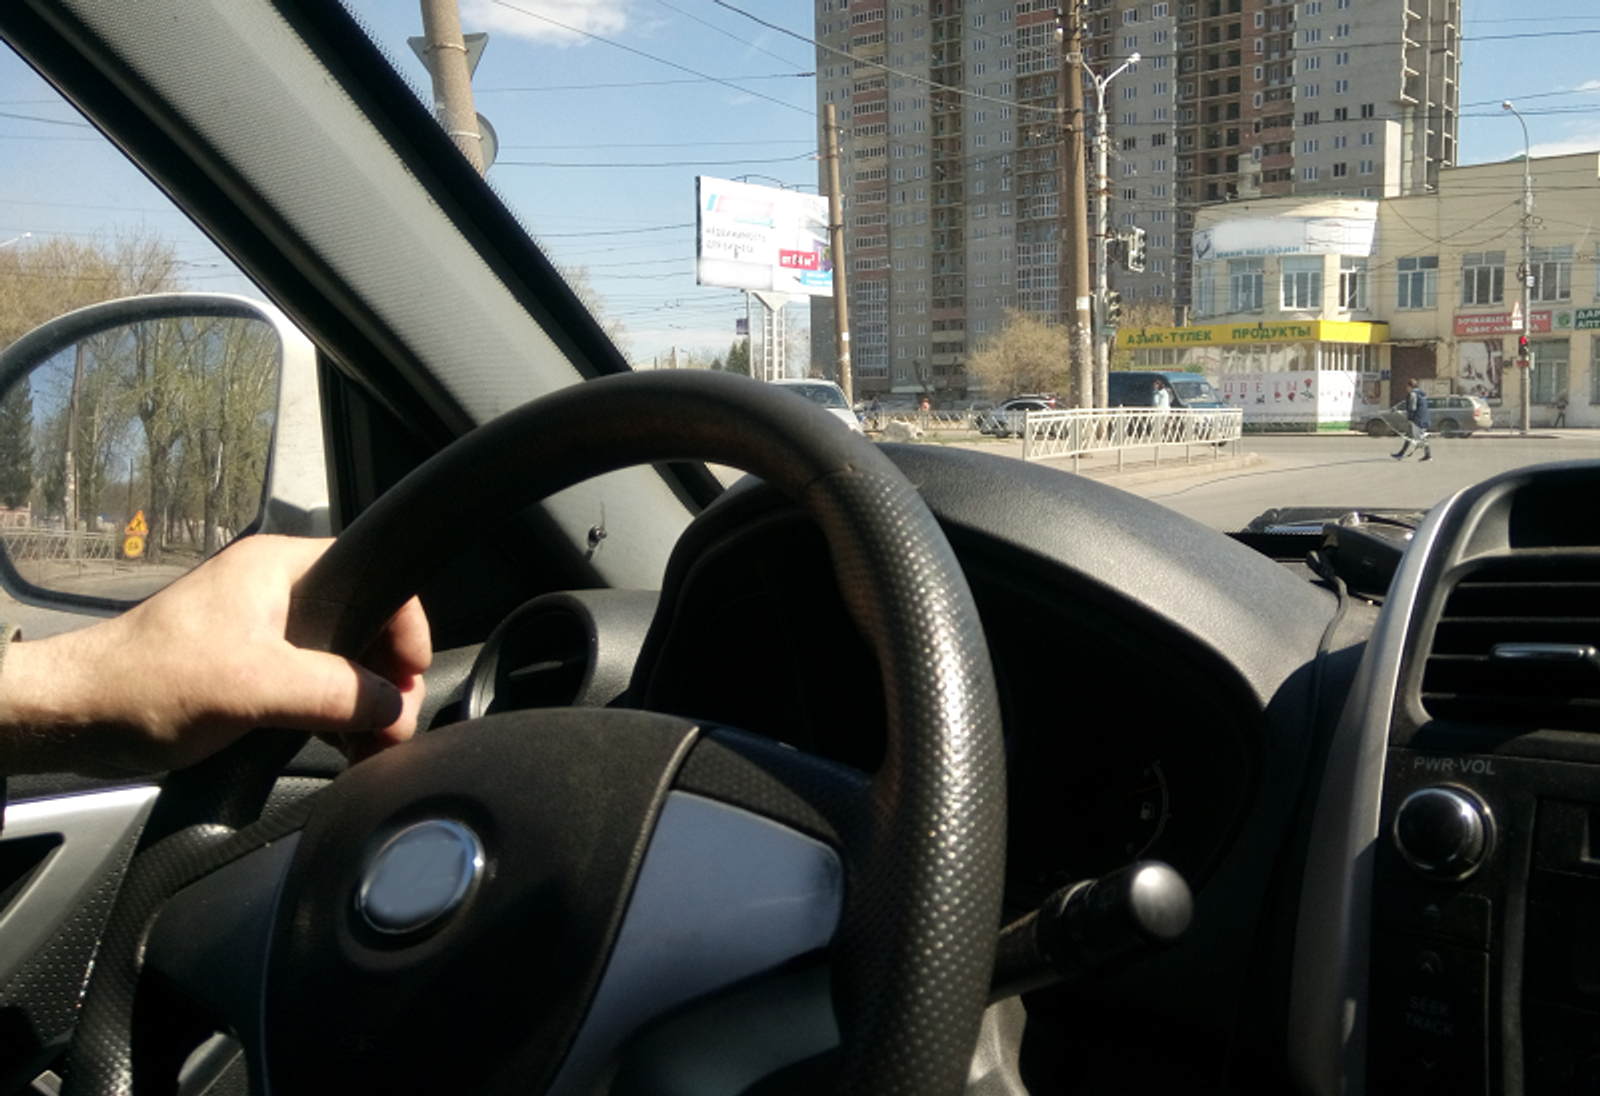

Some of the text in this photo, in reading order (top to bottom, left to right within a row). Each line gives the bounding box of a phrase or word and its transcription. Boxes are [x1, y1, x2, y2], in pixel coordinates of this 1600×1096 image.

[1232, 325, 1311, 340] ПРОДУКТЫ
[1409, 995, 1450, 1018] SEEK
[1404, 1011, 1455, 1037] TRACK
